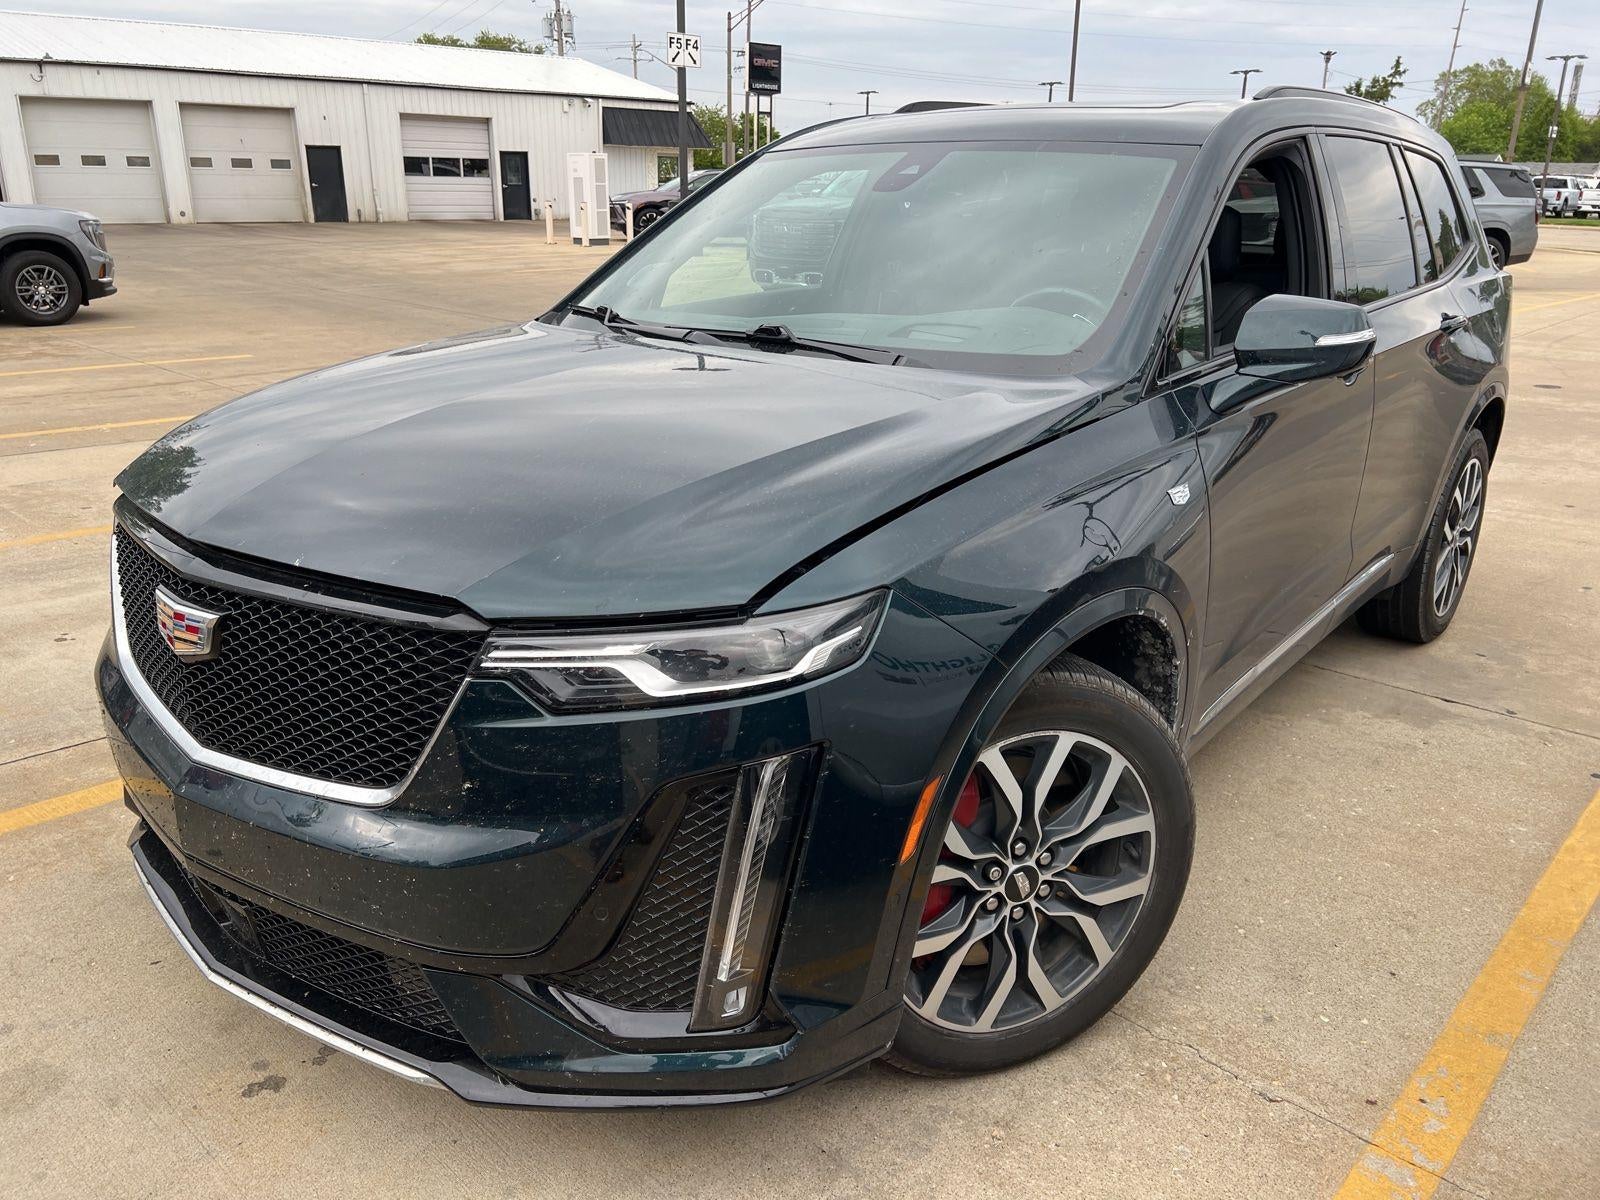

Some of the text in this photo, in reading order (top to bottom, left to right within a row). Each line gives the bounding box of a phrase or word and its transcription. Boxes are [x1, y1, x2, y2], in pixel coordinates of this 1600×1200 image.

[669, 36, 683, 50] F5
[685, 38, 699, 51] F4
[753, 58, 779, 68] GMC
[752, 83, 779, 91] LIGHTHOUSE
